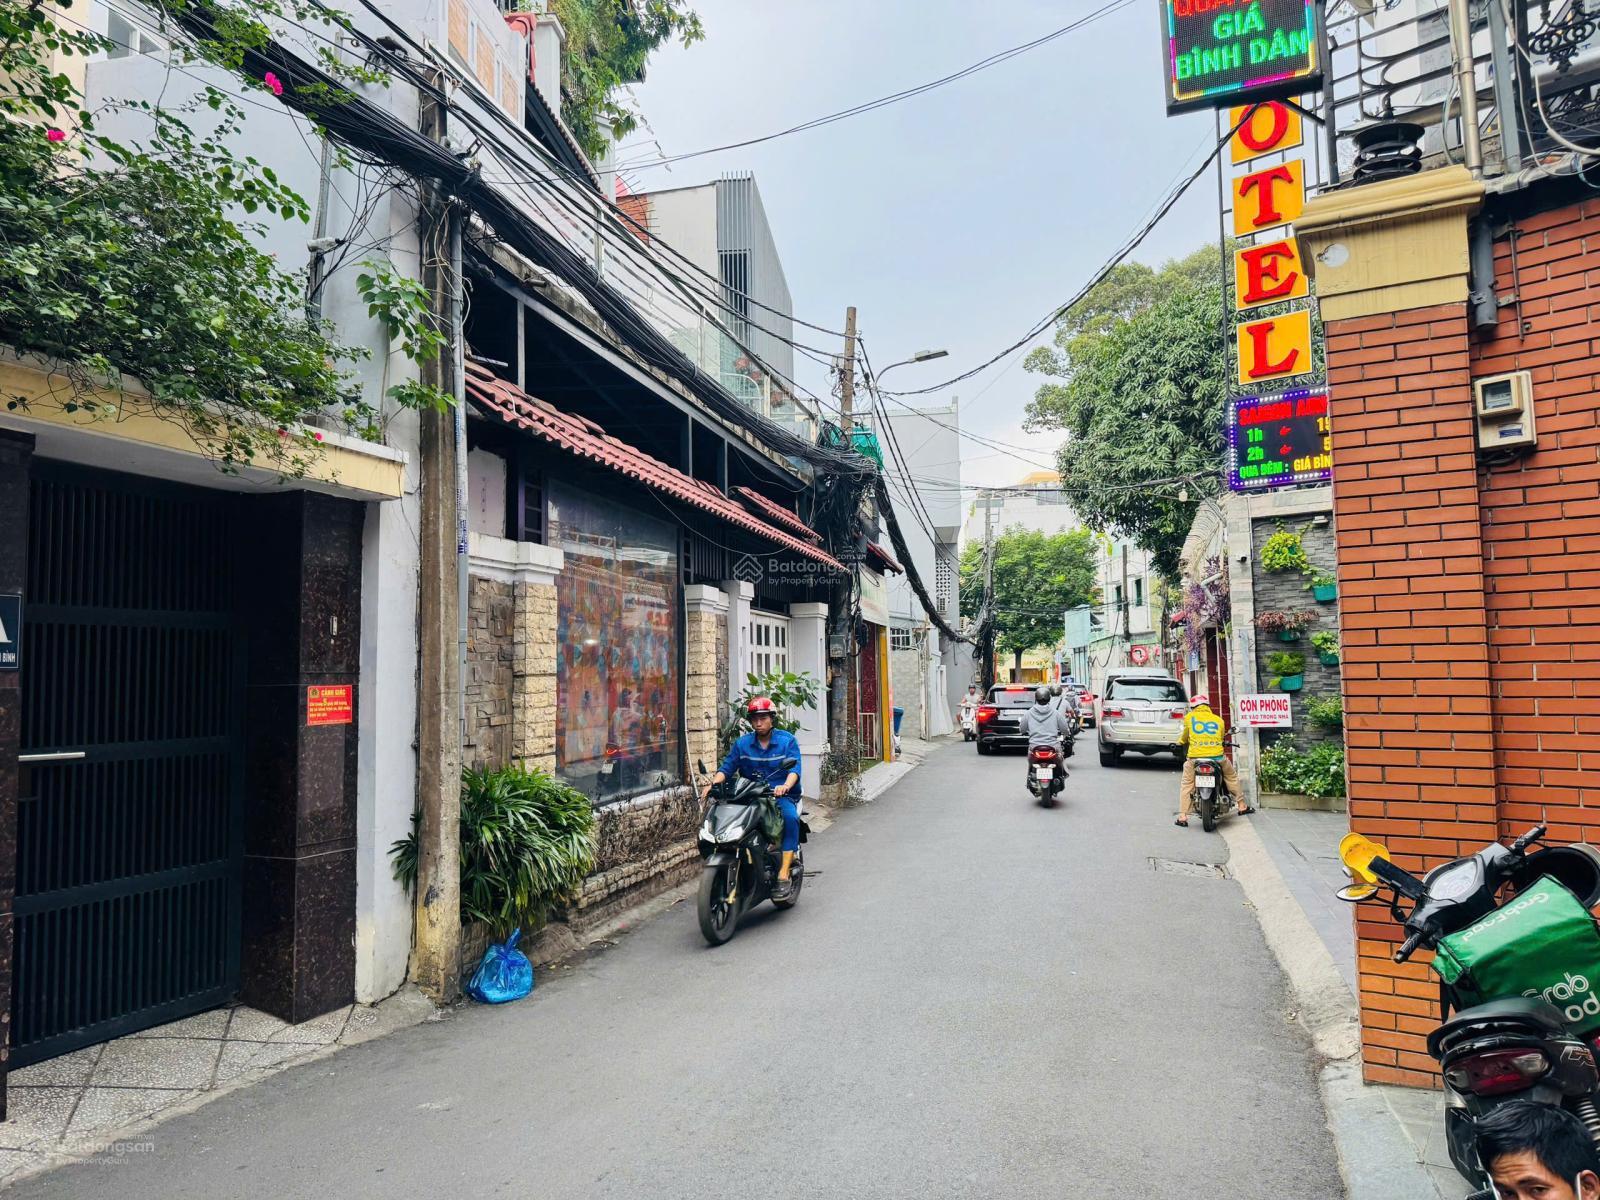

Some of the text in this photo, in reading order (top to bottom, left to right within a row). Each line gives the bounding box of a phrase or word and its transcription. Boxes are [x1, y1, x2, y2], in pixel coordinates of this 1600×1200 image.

[1213, 1, 1265, 39] GIÁ
[1176, 27, 1309, 80] BÌNH DÂN
[1247, 428, 1263, 442] 1h
[1247, 446, 1264, 461] 2h
[1293, 455, 1311, 472] GIÁ
[1240, 696, 1289, 711] CÒN PHÒNG
[1192, 716, 1218, 735] be
[1462, 892, 1549, 942] GrabFood
